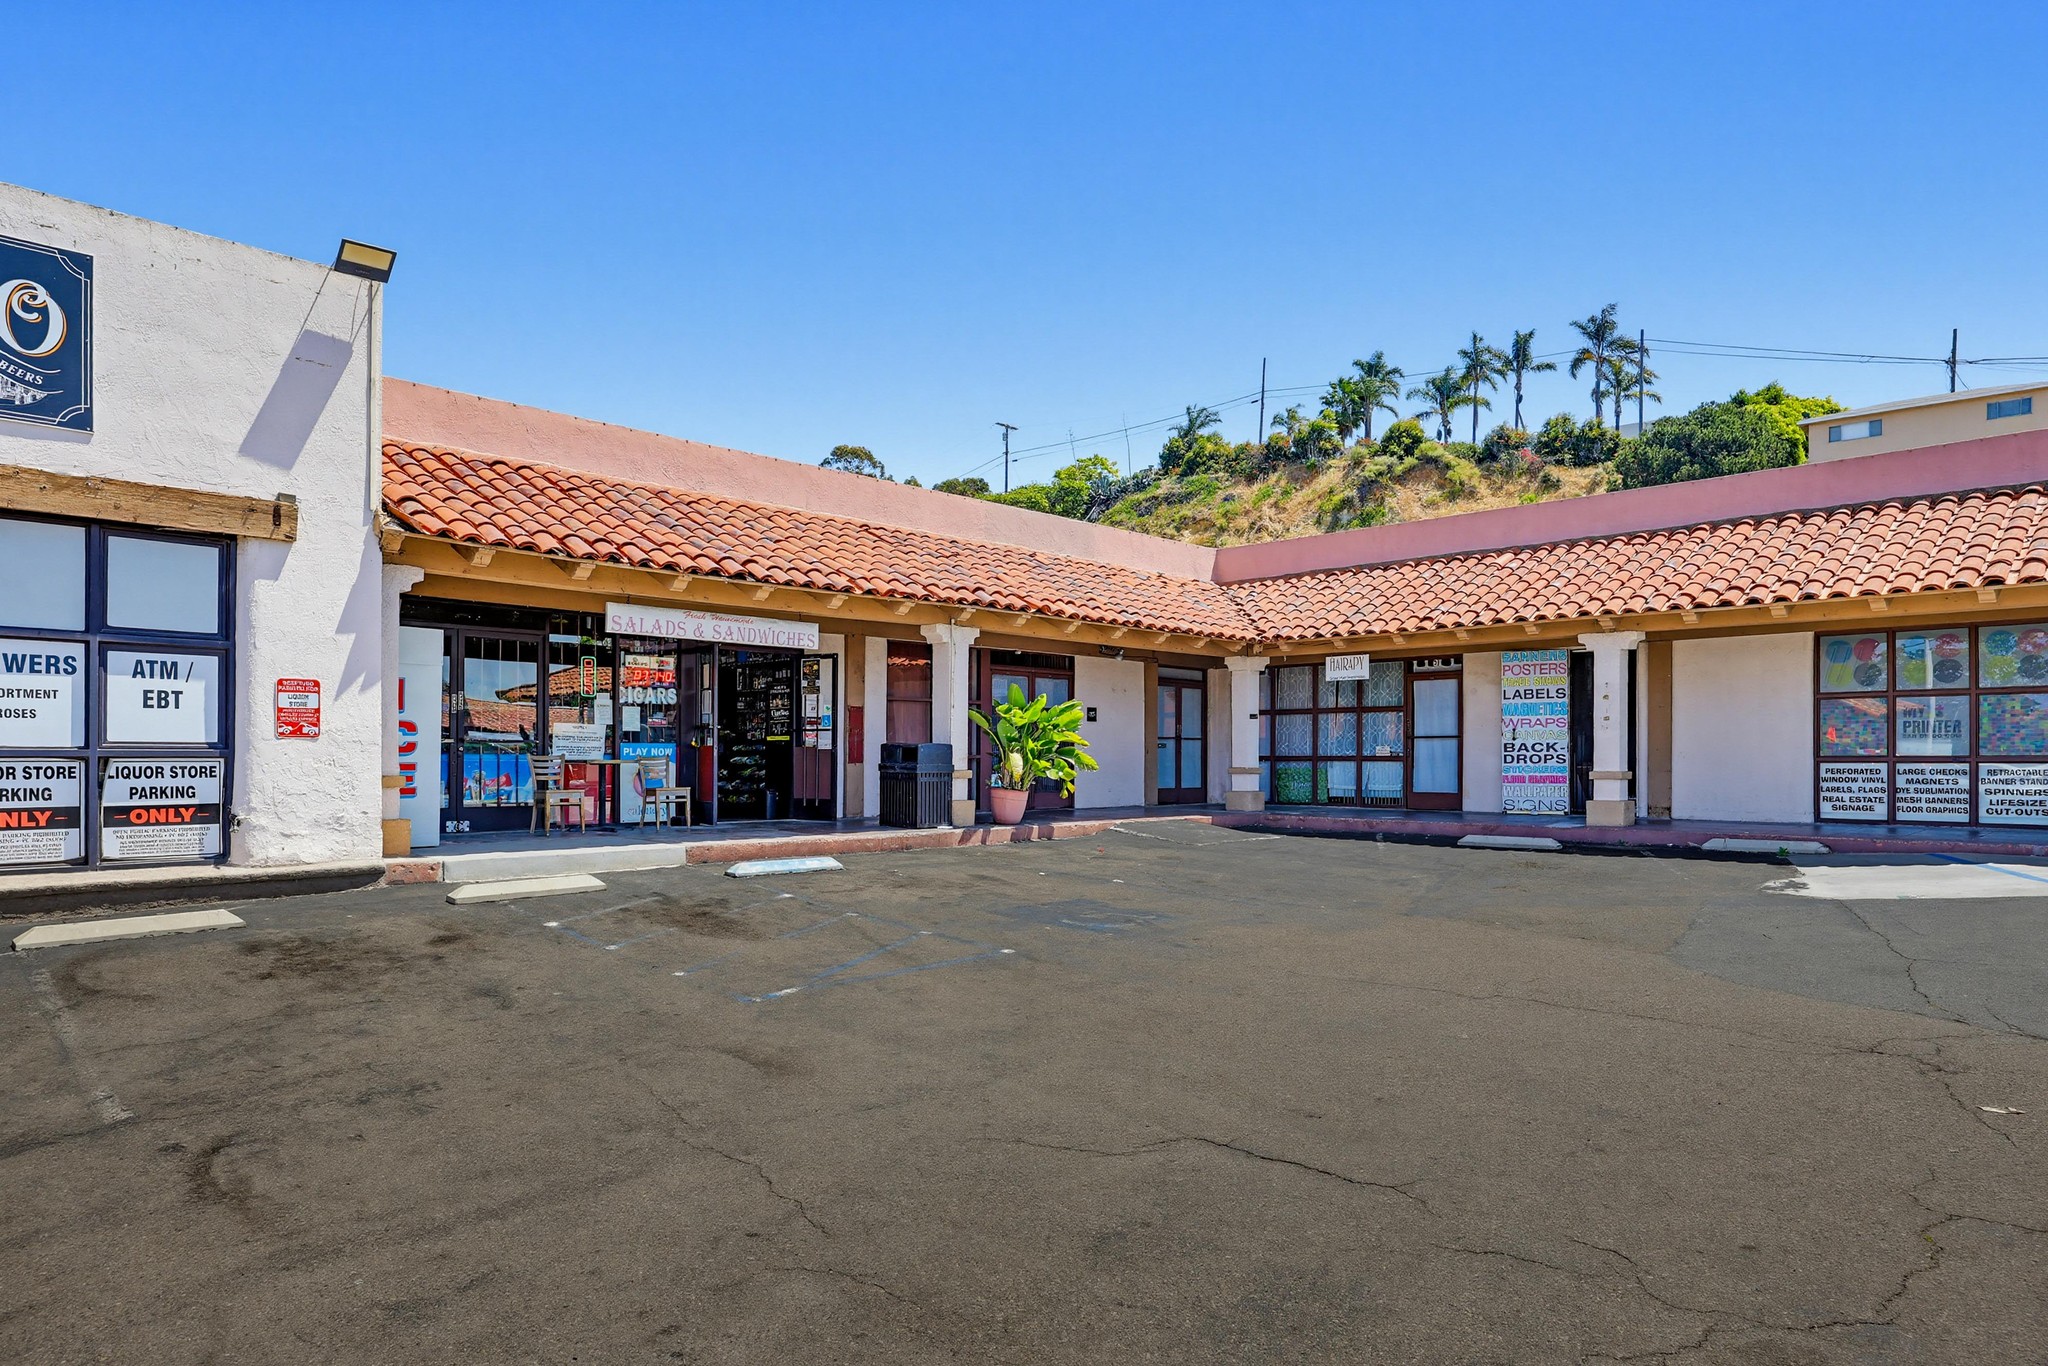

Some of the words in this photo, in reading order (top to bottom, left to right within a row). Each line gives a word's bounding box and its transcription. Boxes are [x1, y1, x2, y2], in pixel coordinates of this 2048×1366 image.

[0, 359, 44, 385] BEERS
[611, 614, 687, 637] SALADS
[693, 622, 704, 640] &
[712, 624, 815, 648] SANDWICHES
[1502, 650, 1567, 662] BANNERS
[2, 653, 78, 675] WERS
[1330, 656, 1365, 671] HAIRAPY
[132, 659, 178, 680] ATM
[1503, 663, 1567, 676] POSTERS
[143, 689, 184, 709] EBT
[1503, 688, 1567, 700] LABELS
[1503, 701, 1568, 716] MAGNETICS
[1501, 718, 1567, 728] WRAPS
[1903, 720, 1962, 733] PRINTER
[1504, 730, 1567, 740] CANVAS
[623, 747, 648, 756] PLAY
[651, 747, 673, 756] NOW
[1504, 742, 1565, 753] BACK-
[1504, 754, 1567, 764] DROPS
[22, 766, 77, 780] STORE
[107, 766, 164, 780] LIQUOR
[169, 765, 218, 779] STORE
[1503, 766, 1567, 774] STICKERS
[1897, 768, 1926, 776] LARGE
[1929, 768, 1968, 776] CHECKS
[1861, 776, 1886, 784] VINYL
[129, 786, 196, 800] PARKING
[1503, 786, 1567, 797] WALLPAPER
[1858, 786, 1887, 794] FLAGS
[1914, 787, 1969, 795] SUBLIMATION
[1503, 799, 1567, 811] SIGNS
[1822, 795, 1846, 803] REAL
[1849, 796, 1885, 804] ESTATE
[1925, 797, 1968, 805] BANNERS
[1832, 804, 1875, 812] SIGNAGE
[1926, 806, 1968, 814] GRAPHICS
[1986, 808, 2048, 816] CUT-OUTS
[129, 807, 197, 824] ONLY
